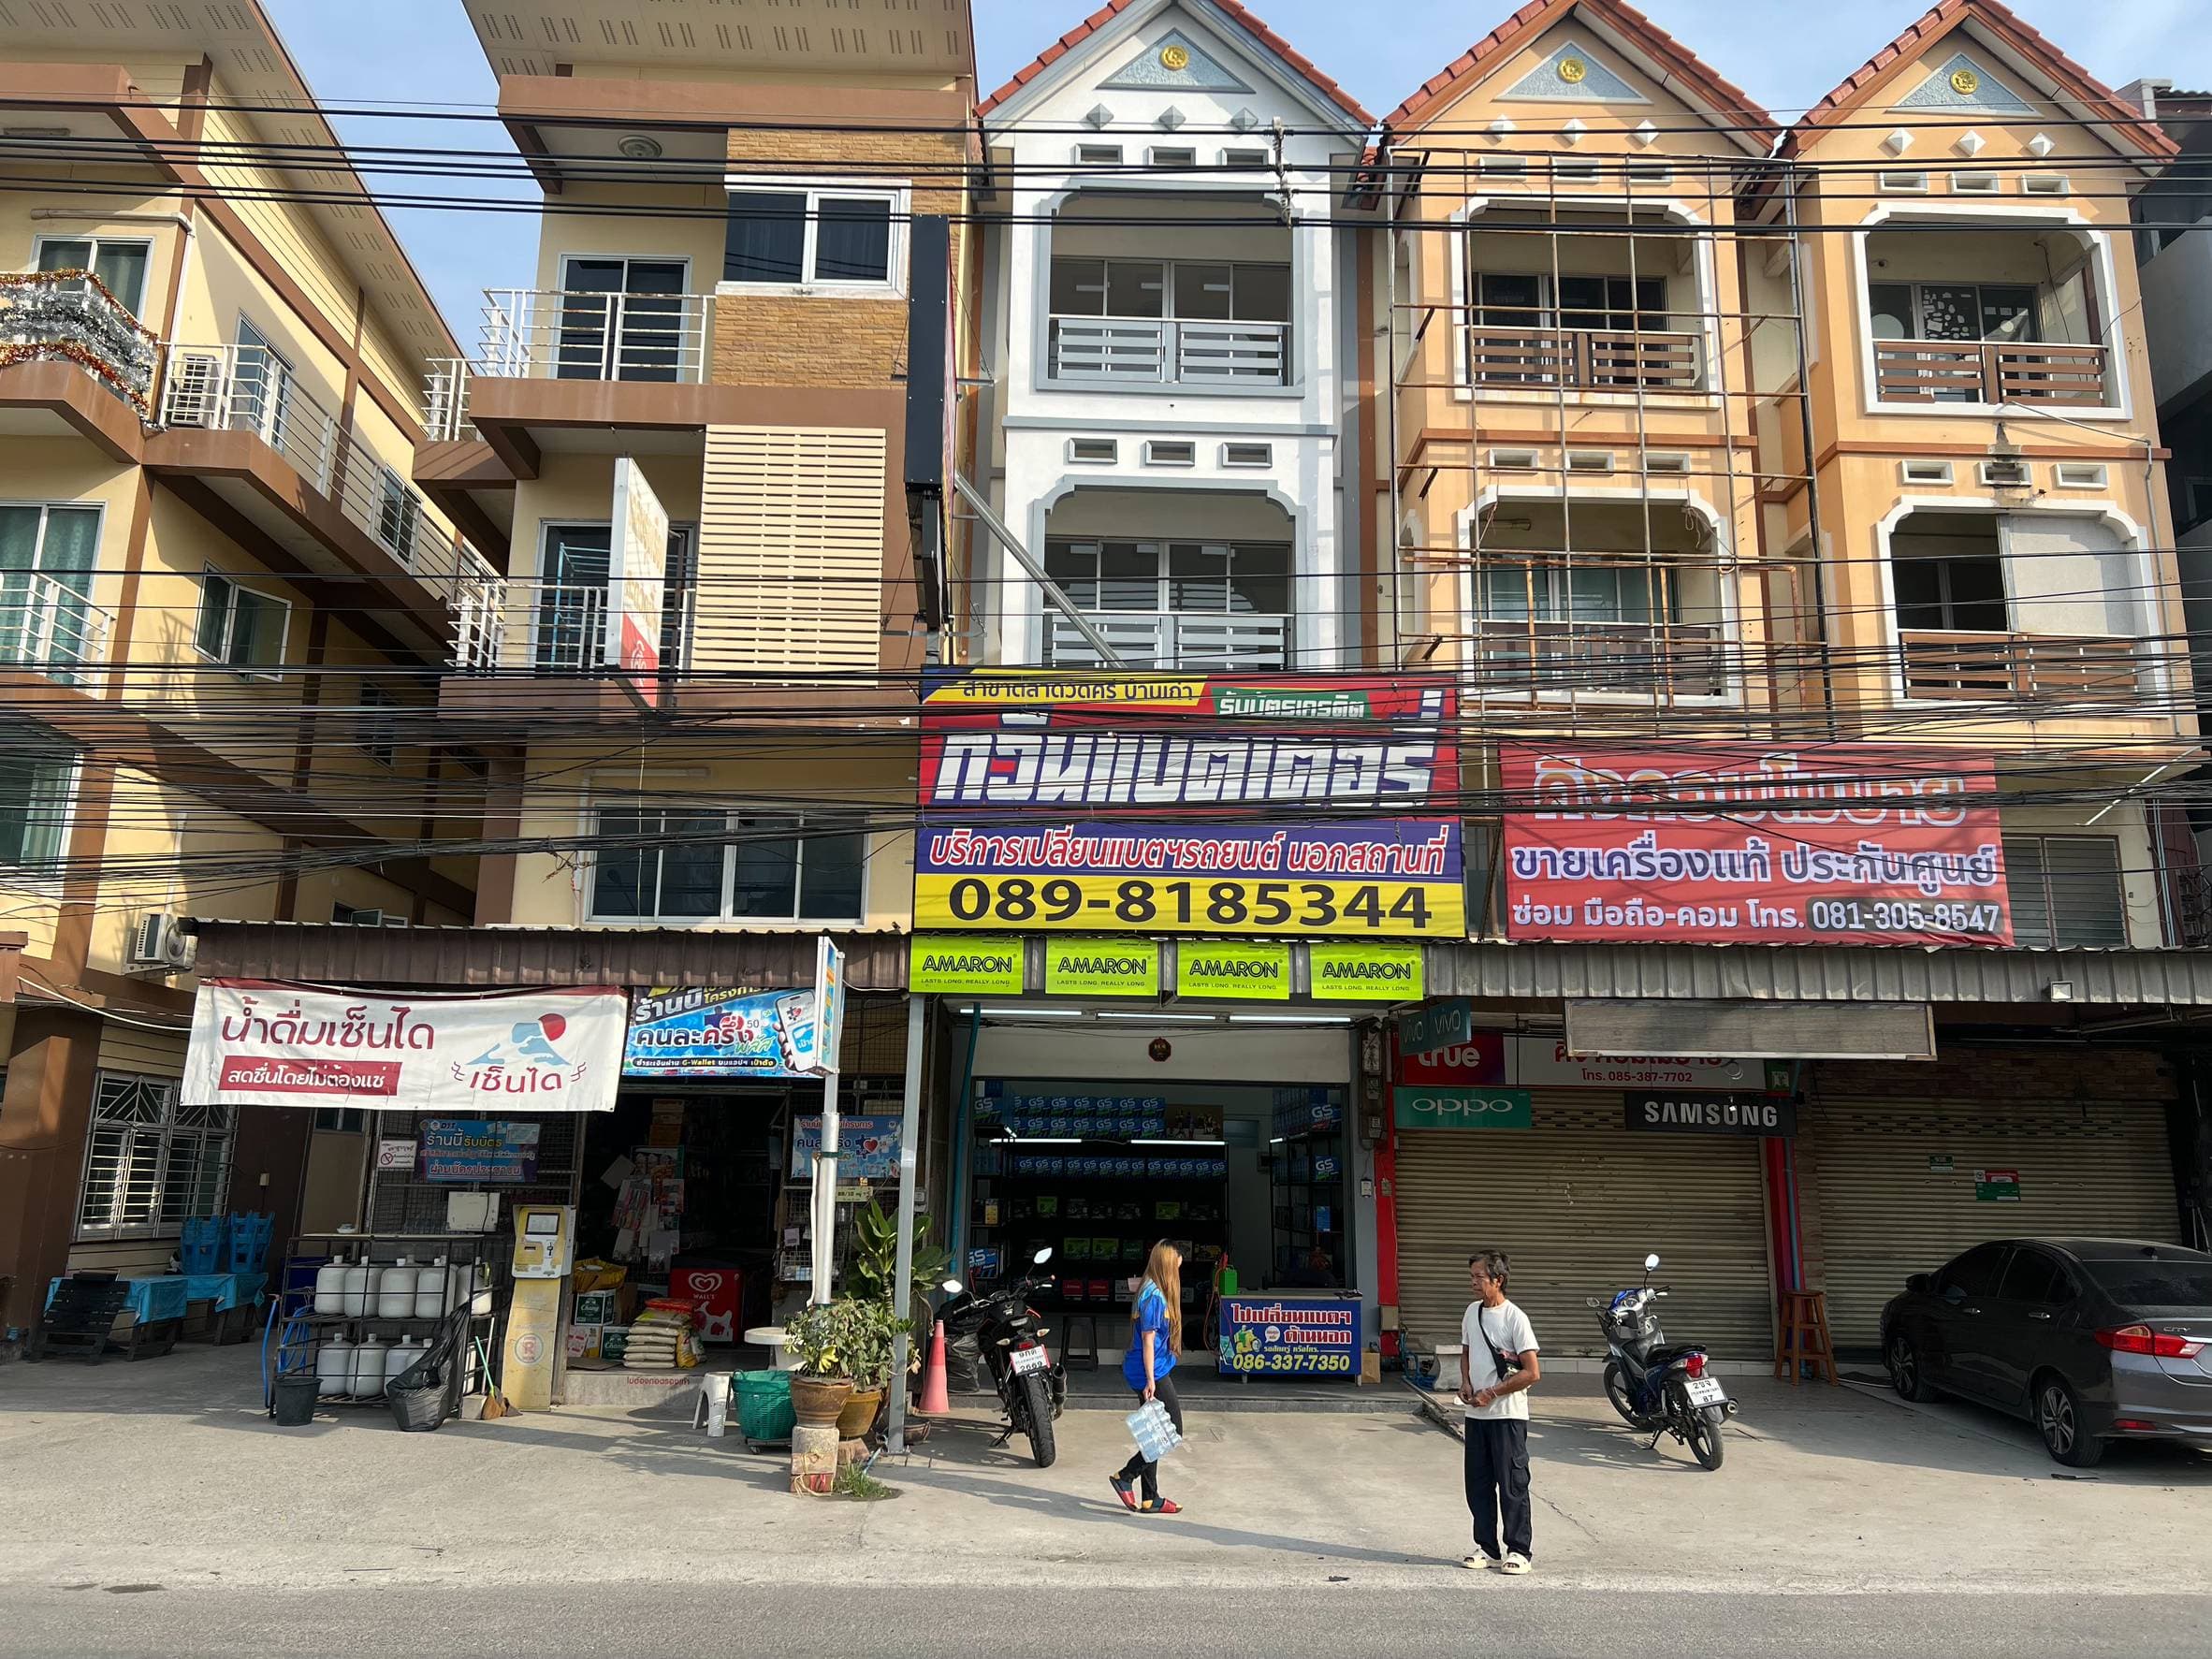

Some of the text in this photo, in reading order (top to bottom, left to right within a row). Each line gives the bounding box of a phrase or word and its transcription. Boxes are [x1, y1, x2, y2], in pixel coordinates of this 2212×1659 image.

[963, 677, 1117, 700] สาขาตลาดวดศรี
[1288, 824, 1449, 875] นอกสถานที่
[1510, 830, 1997, 896] ขายเครื่องแท้ ประกันศูนย์
[949, 878, 1433, 929] 089-8185344
[1512, 894, 1999, 933] ซ่อม มือถือ-คอม โทร. 081-305-8547
[922, 954, 1012, 973] AMARON
[1057, 956, 1147, 975] AMARON
[1189, 959, 1278, 978] AMARON
[1322, 961, 1411, 980] AMARON
[635, 987, 703, 1023] ร้านนี
[221, 996, 435, 1051] น้ำดื่มเซ็นได
[636, 1015, 755, 1047] คนละครึ่ง
[735, 1033, 776, 1054] พลัส
[682, 1058, 716, 1067] G-Wallet
[226, 1061, 387, 1091] สดชื่นโดยไม่ต้องแช่
[468, 1066, 562, 1094] เซ็นได
[1581, 1068, 1693, 1083] โทร. 085-387-7702
[975, 1097, 994, 1110] GS
[1028, 1096, 1044, 1107] GS
[1052, 1097, 1068, 1107] GS
[1074, 1097, 1090, 1108] GS
[1097, 1098, 1113, 1108] GS
[1119, 1098, 1136, 1108] GS
[1142, 1098, 1158, 1108] GS
[1411, 1098, 1513, 1116] oppo
[1311, 1104, 1333, 1118] GS
[1643, 1100, 1778, 1128] SAMSUNG
[1027, 1117, 1043, 1128] GS
[1051, 1117, 1067, 1128] GS
[1073, 1118, 1089, 1128] GS
[1096, 1118, 1112, 1128] GS
[1119, 1118, 1135, 1128] GS
[1142, 1118, 1157, 1128] GS
[1316, 1158, 1334, 1171] GS
[1284, 1325, 1352, 1345] ด้านนอก
[1232, 1353, 1350, 1371] 086-337-7350
